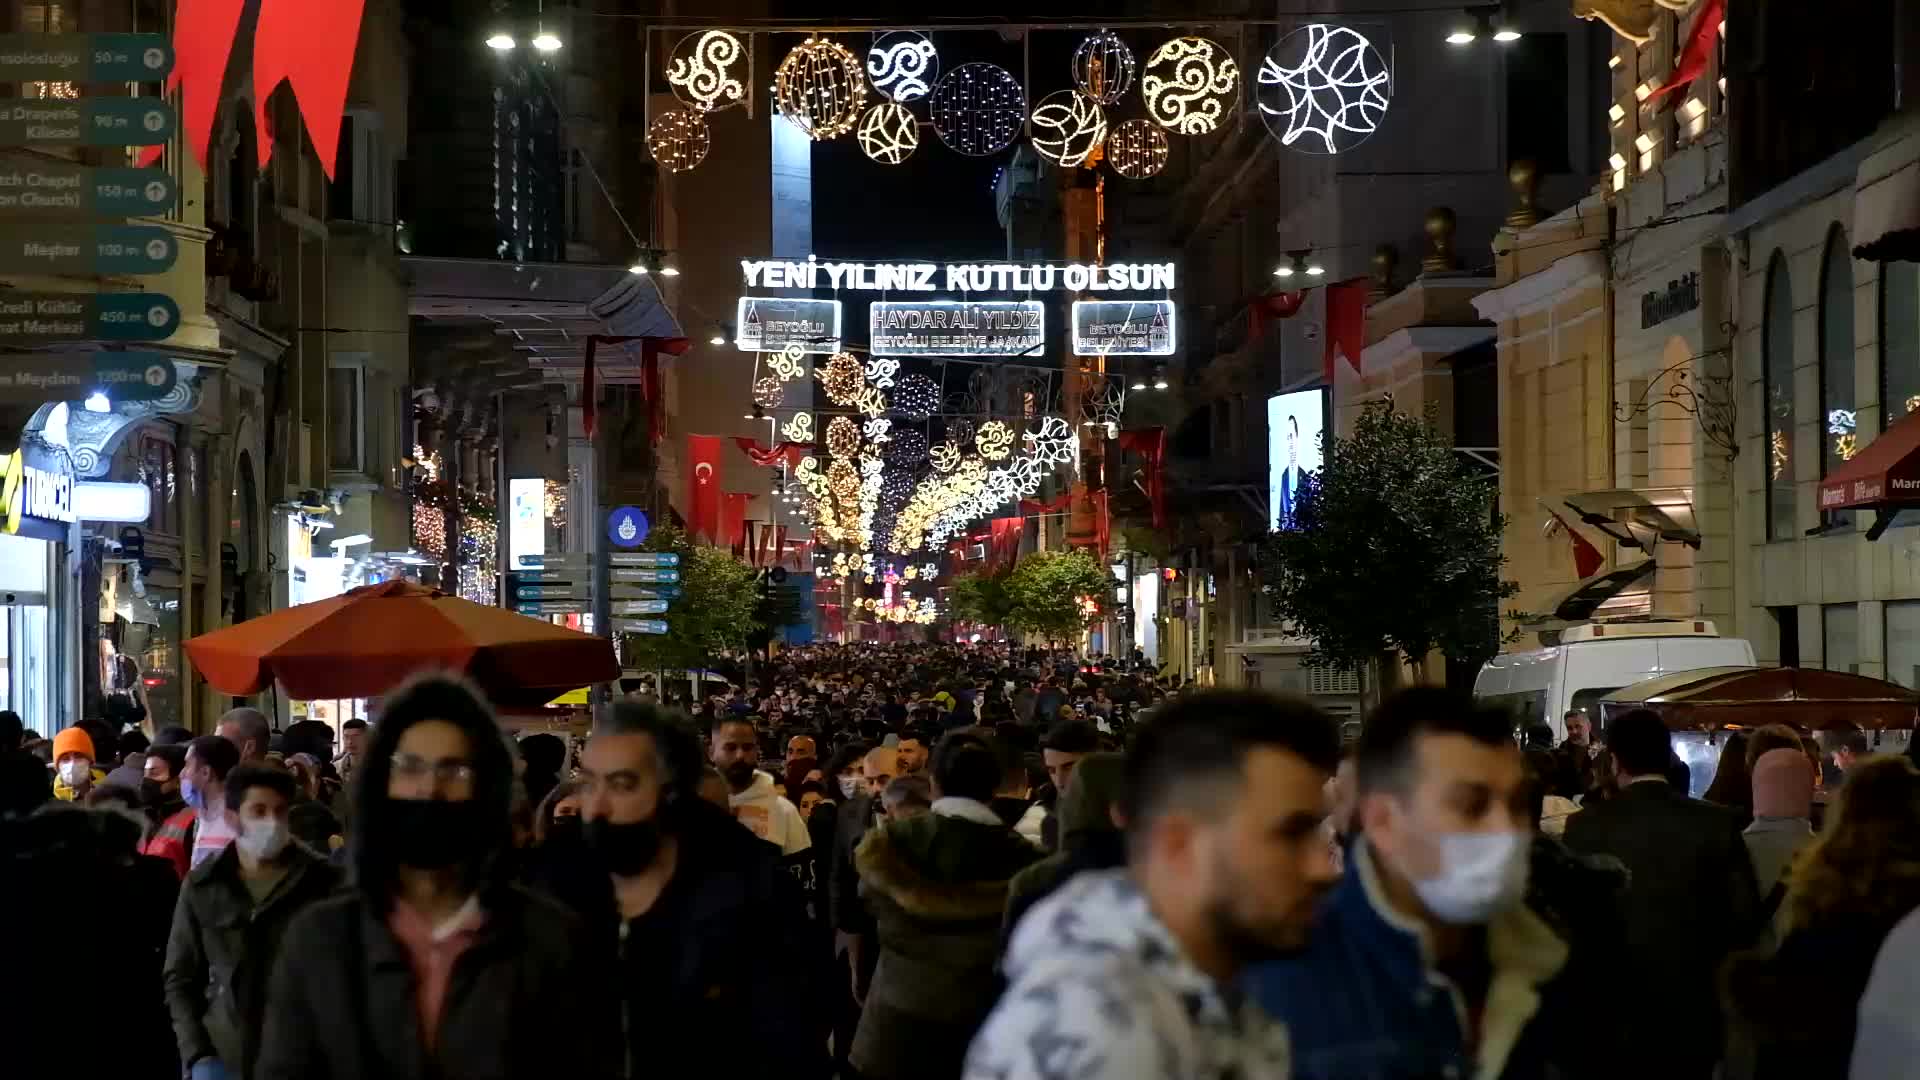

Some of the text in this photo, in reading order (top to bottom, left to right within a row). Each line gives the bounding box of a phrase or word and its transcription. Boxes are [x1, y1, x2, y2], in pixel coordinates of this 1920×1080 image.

[95, 51, 112, 64] 50
[26, 173, 80, 191] Chapel
[20, 192, 80, 208] Church)
[742, 254, 1176, 291] YENİ YILINIZ KUTLU OLSUN
[99, 311, 126, 323] 450
[873, 306, 1040, 330] HAYDAR ALİ YILDIZ
[23, 320, 85, 335] Merkezi
[765, 319, 825, 334] BEYOĞLU
[873, 332, 928, 348] BEYOĞLU
[930, 332, 987, 348] BELEDİYE
